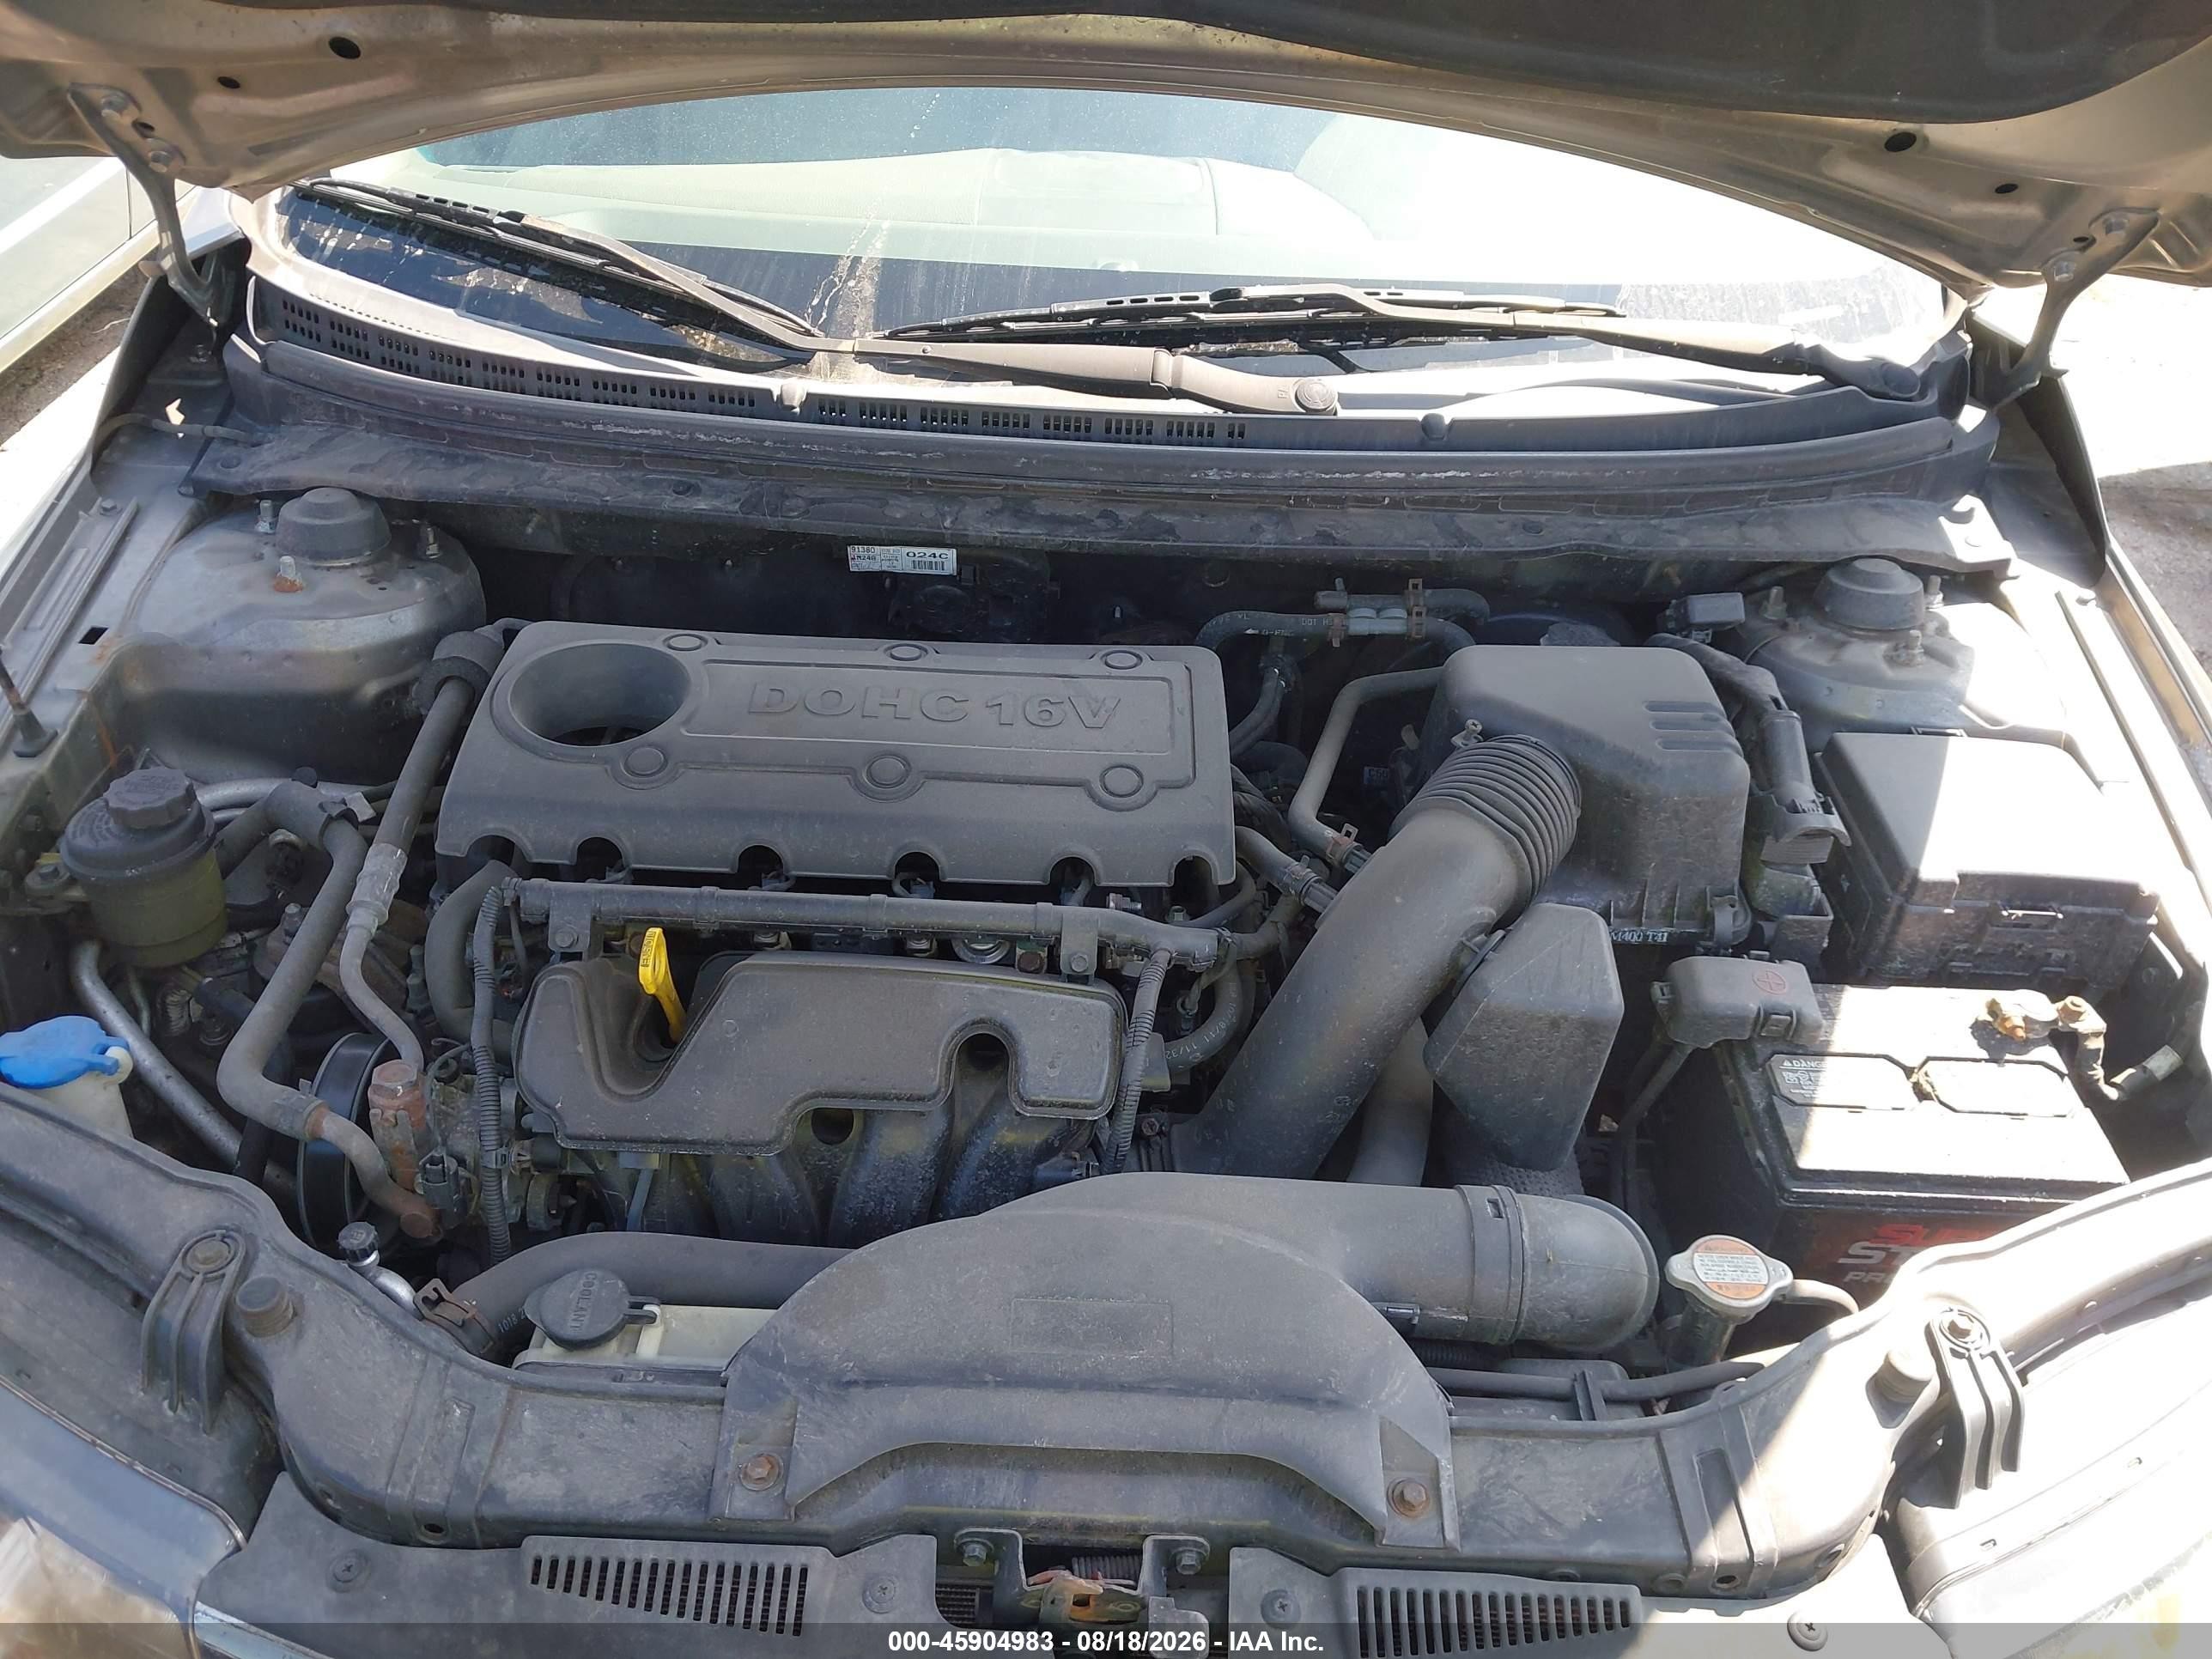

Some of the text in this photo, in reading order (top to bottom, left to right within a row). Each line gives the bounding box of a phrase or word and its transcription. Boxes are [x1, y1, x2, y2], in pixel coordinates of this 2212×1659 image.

[748, 683, 1121, 730] DOHC 16V
[569, 1272, 599, 1330] COOLANT
